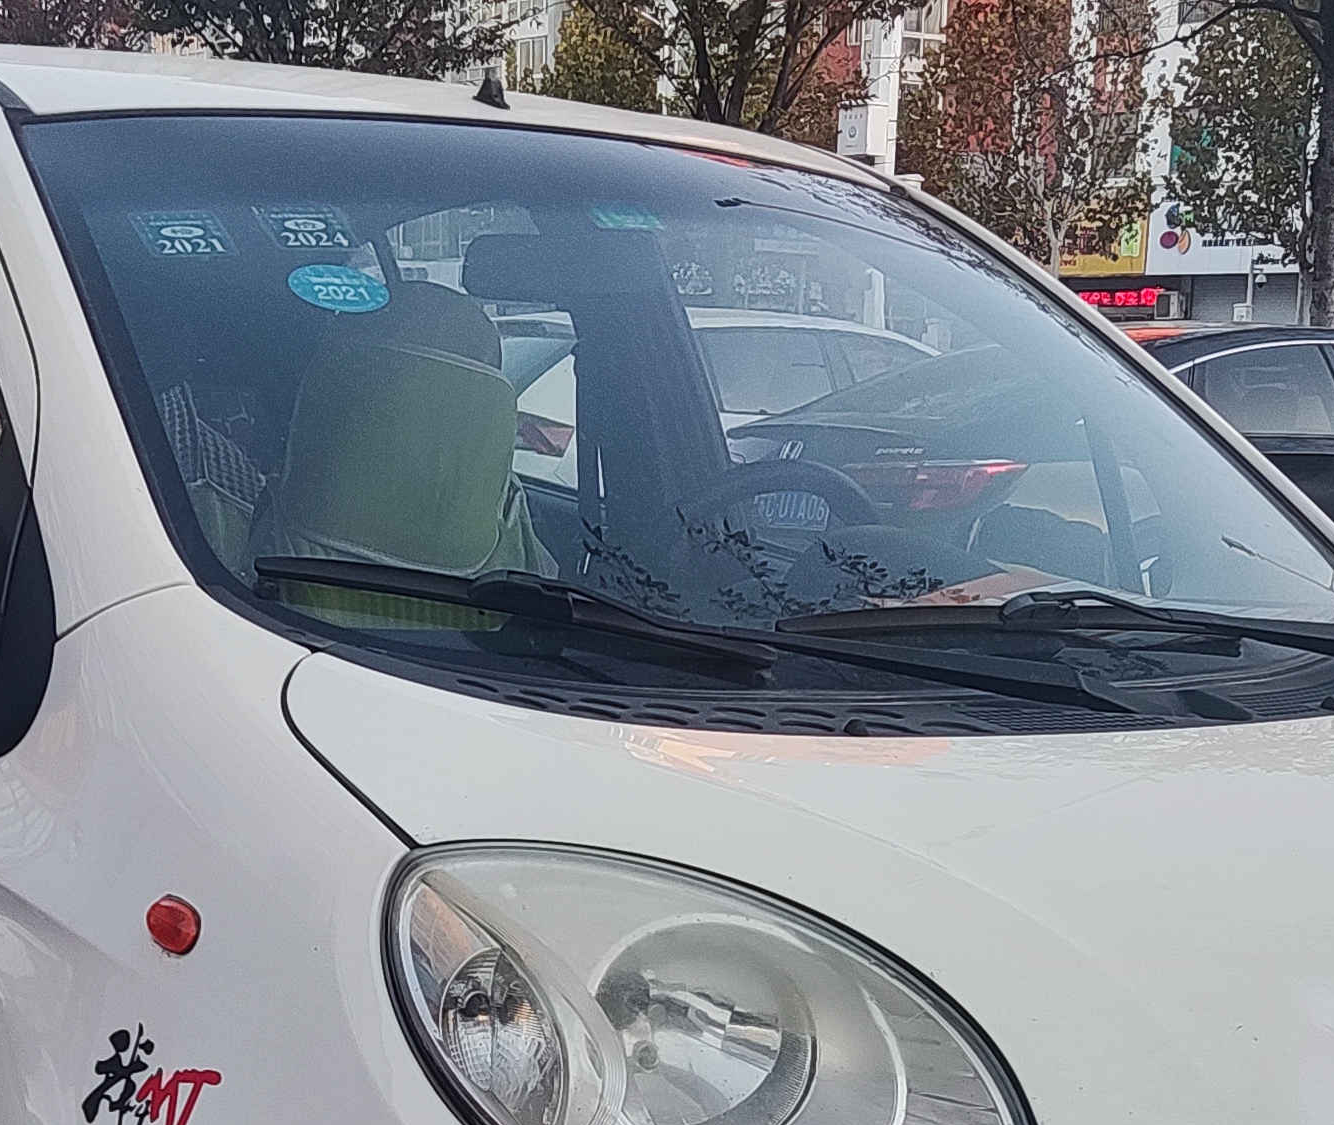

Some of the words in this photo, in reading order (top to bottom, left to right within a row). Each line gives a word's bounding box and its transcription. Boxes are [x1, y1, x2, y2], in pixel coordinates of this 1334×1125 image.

[157, 238, 227, 254] 2021
[280, 231, 349, 247] 2024
[313, 284, 371, 302] 2021
